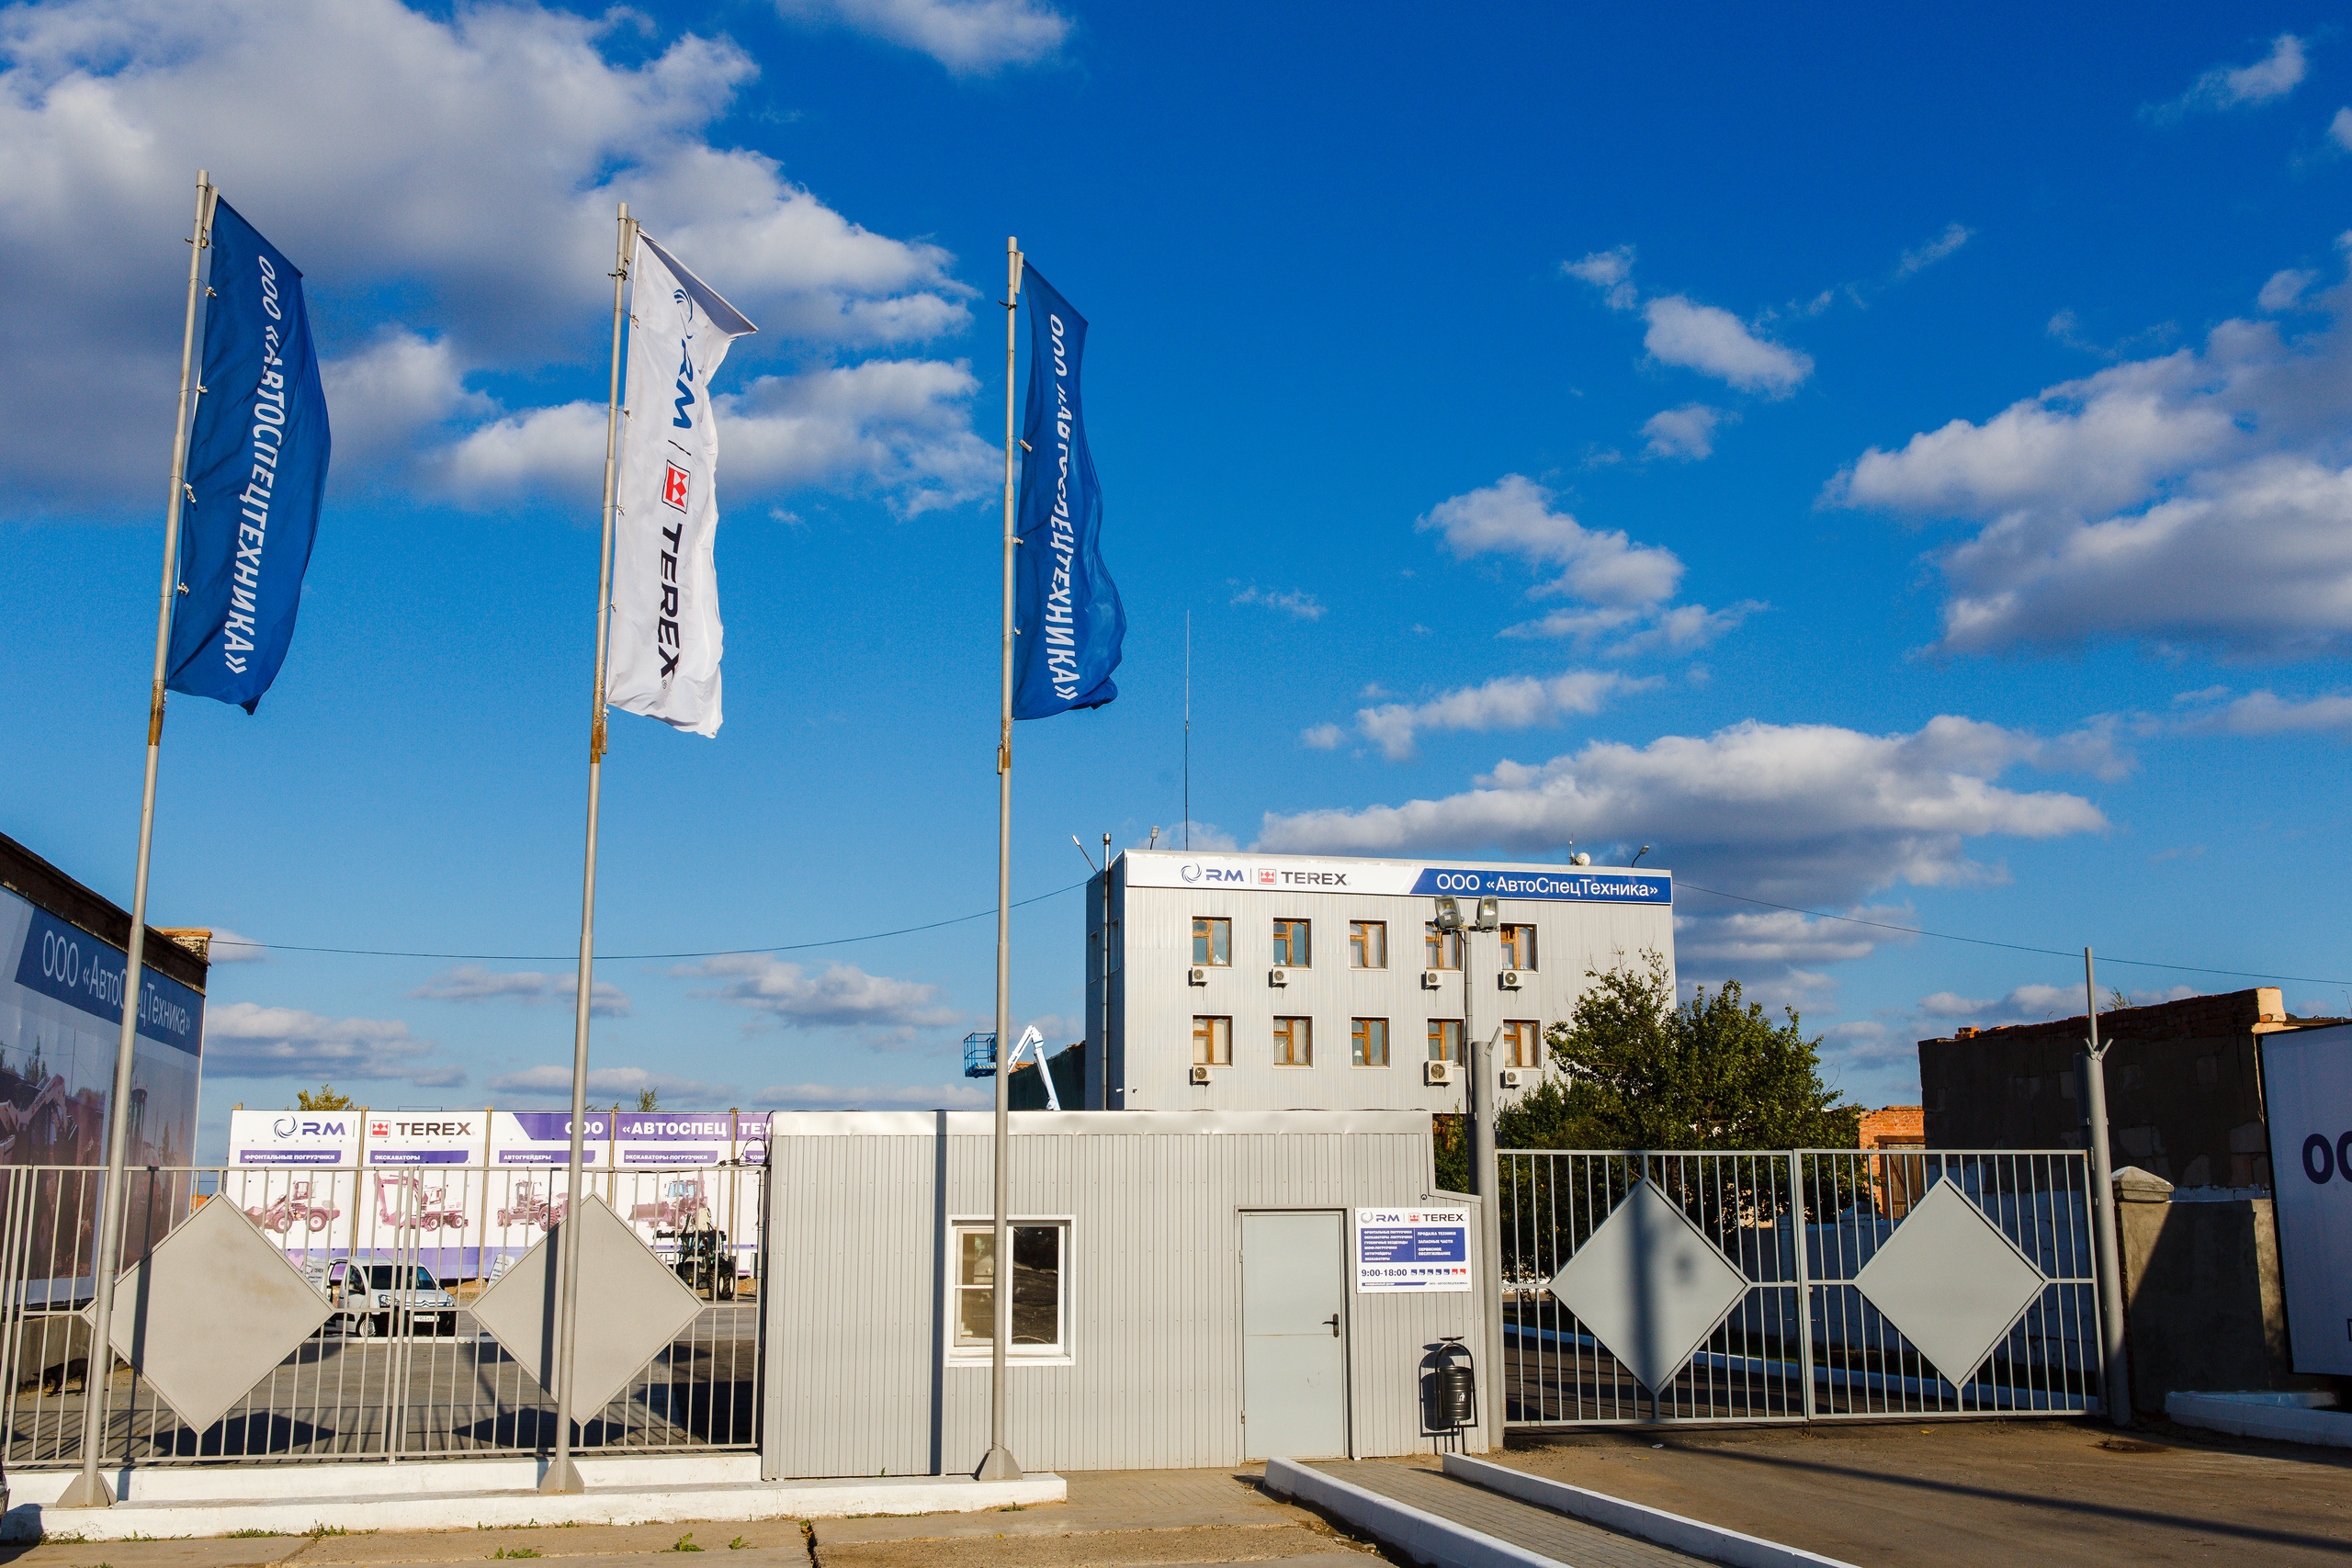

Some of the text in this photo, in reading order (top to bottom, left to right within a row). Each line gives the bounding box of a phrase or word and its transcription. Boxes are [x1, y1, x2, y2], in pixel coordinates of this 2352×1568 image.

[673, 338, 695, 430] RM
[223, 254, 286, 675] ООО «АВТОСПЕЦТЕХНИКА»
[659, 523, 683, 680] TEREX
[1205, 869, 1244, 883] RM
[1281, 872, 1347, 886] TEREX
[1436, 874, 1658, 897] ООО «АвтоСпецТехника»
[42, 930, 191, 1036] ООО «АвтоСцТехника»
[301, 1122, 345, 1135] RM
[396, 1122, 471, 1136] TEREX
[503, 1153, 552, 1161] АВТОГРЕЙДЕРЫ
[1423, 1213, 1464, 1222] TEREX
[1362, 1269, 1408, 1277] 9:00-18:00
